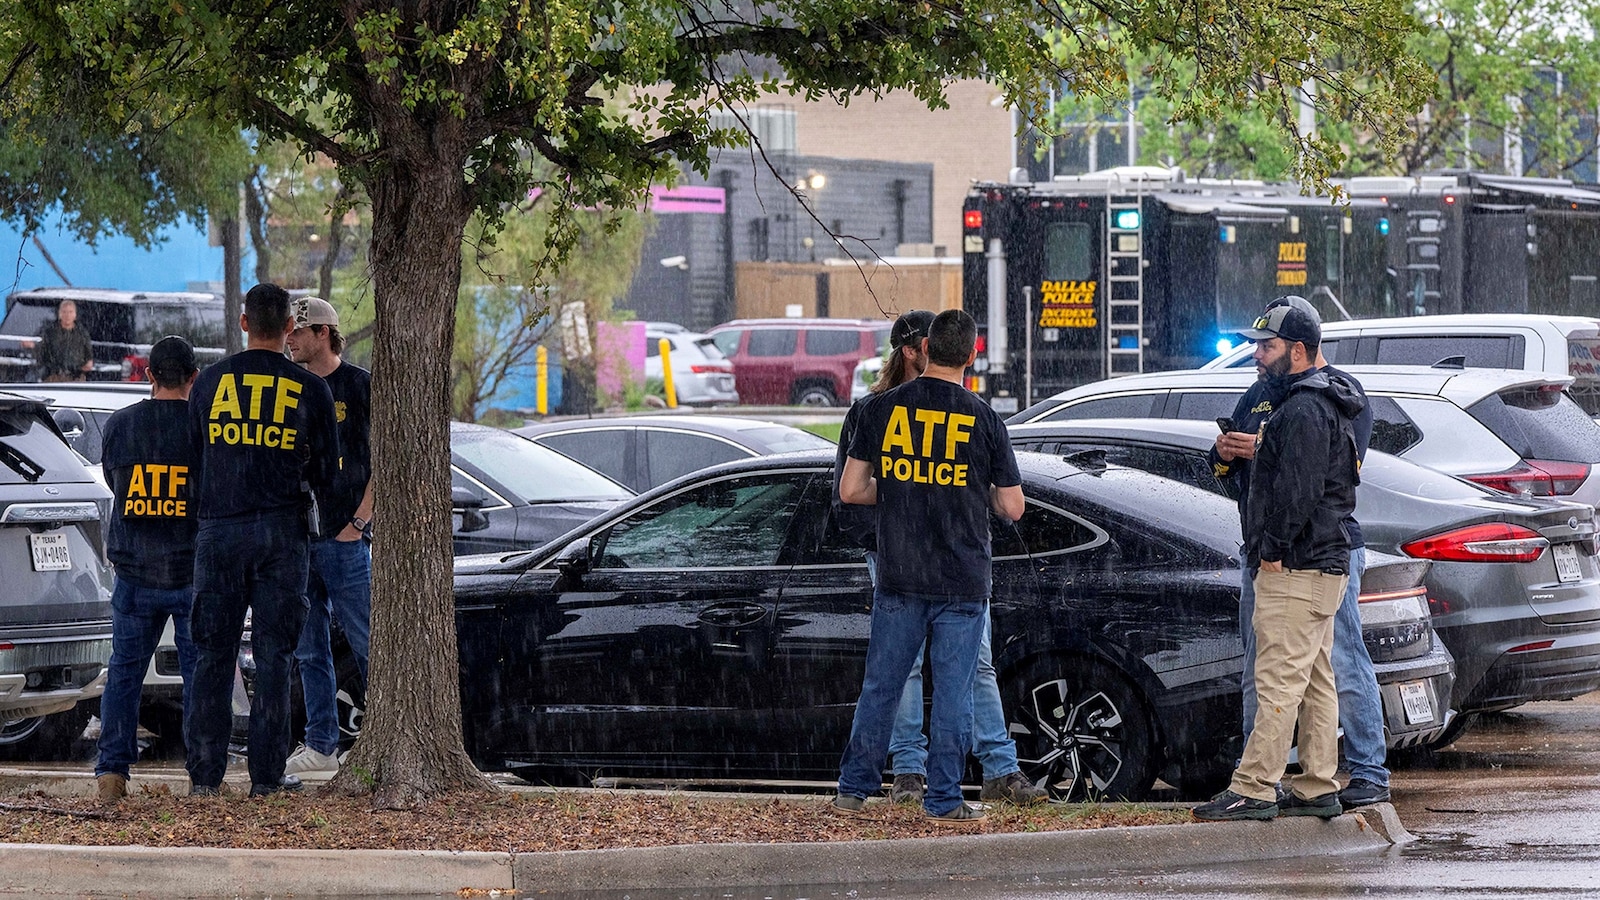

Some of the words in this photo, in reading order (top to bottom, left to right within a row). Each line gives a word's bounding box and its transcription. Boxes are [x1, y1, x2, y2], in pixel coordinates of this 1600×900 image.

[1278, 242, 1307, 262] POLICE
[1276, 270, 1307, 286] COMMAND
[1041, 280, 1097, 293] DALLAS
[1042, 292, 1095, 304] POLICE
[1041, 308, 1095, 318] INCIDENT
[1039, 317, 1097, 328] COMMAND
[210, 373, 303, 423] ATF
[1251, 405, 1273, 414] POLICE
[209, 422, 297, 450] POLICE
[881, 405, 975, 460] ATF
[881, 456, 967, 486] POLICE
[127, 464, 188, 498] ATF
[23, 507, 89, 518] EXPLORER
[124, 499, 187, 517] POLICE
[41, 536, 57, 544] TEXAS
